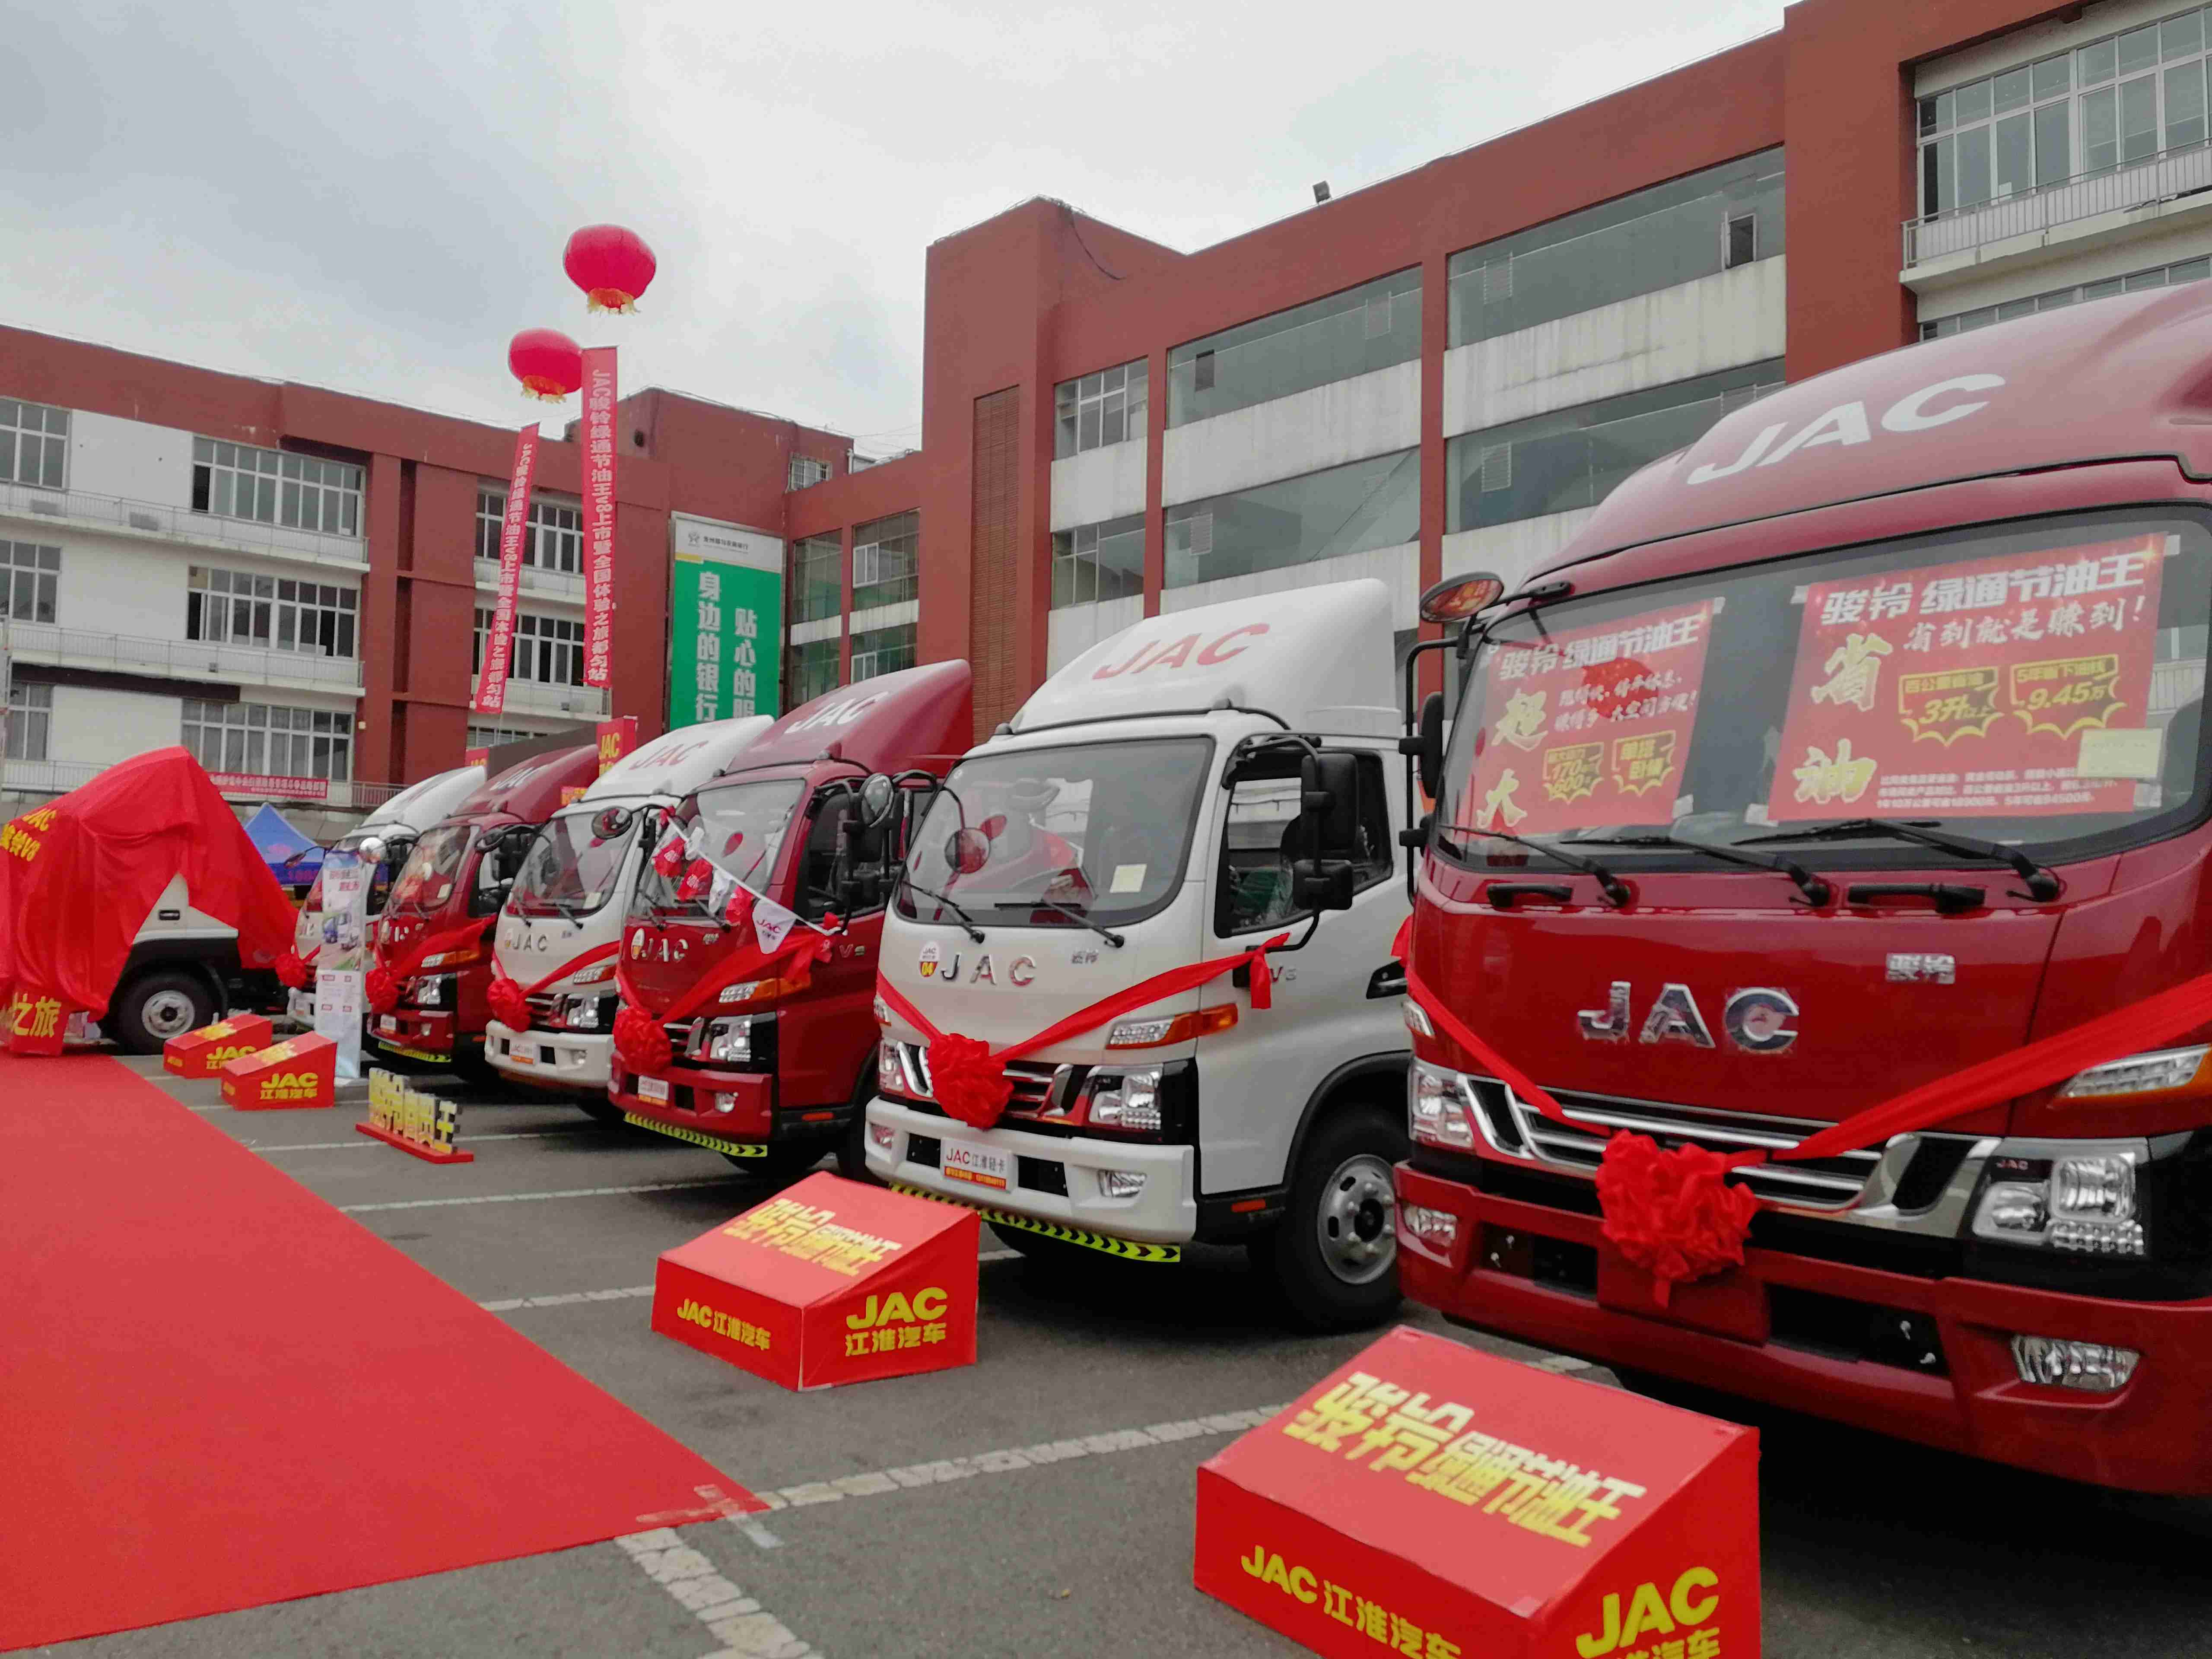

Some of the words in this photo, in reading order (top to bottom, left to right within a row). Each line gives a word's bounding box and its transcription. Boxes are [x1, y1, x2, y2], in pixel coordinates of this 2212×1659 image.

[1687, 373, 2006, 485] JAC
[696, 572, 721, 722] 身边的银行
[1092, 623, 1269, 680] JAC
[784, 691, 889, 734] JAC
[599, 733, 620, 760] JAC
[629, 740, 710, 770] JAC
[512, 934, 548, 951] JAC
[941, 952, 1037, 987] JAC
[1577, 980, 1800, 1051] JAC
[261, 1073, 318, 1089] JAC
[846, 1287, 947, 1331] JAC
[845, 1322, 947, 1358] 江淮汽车
[1576, 1566, 1719, 1659] JAC
